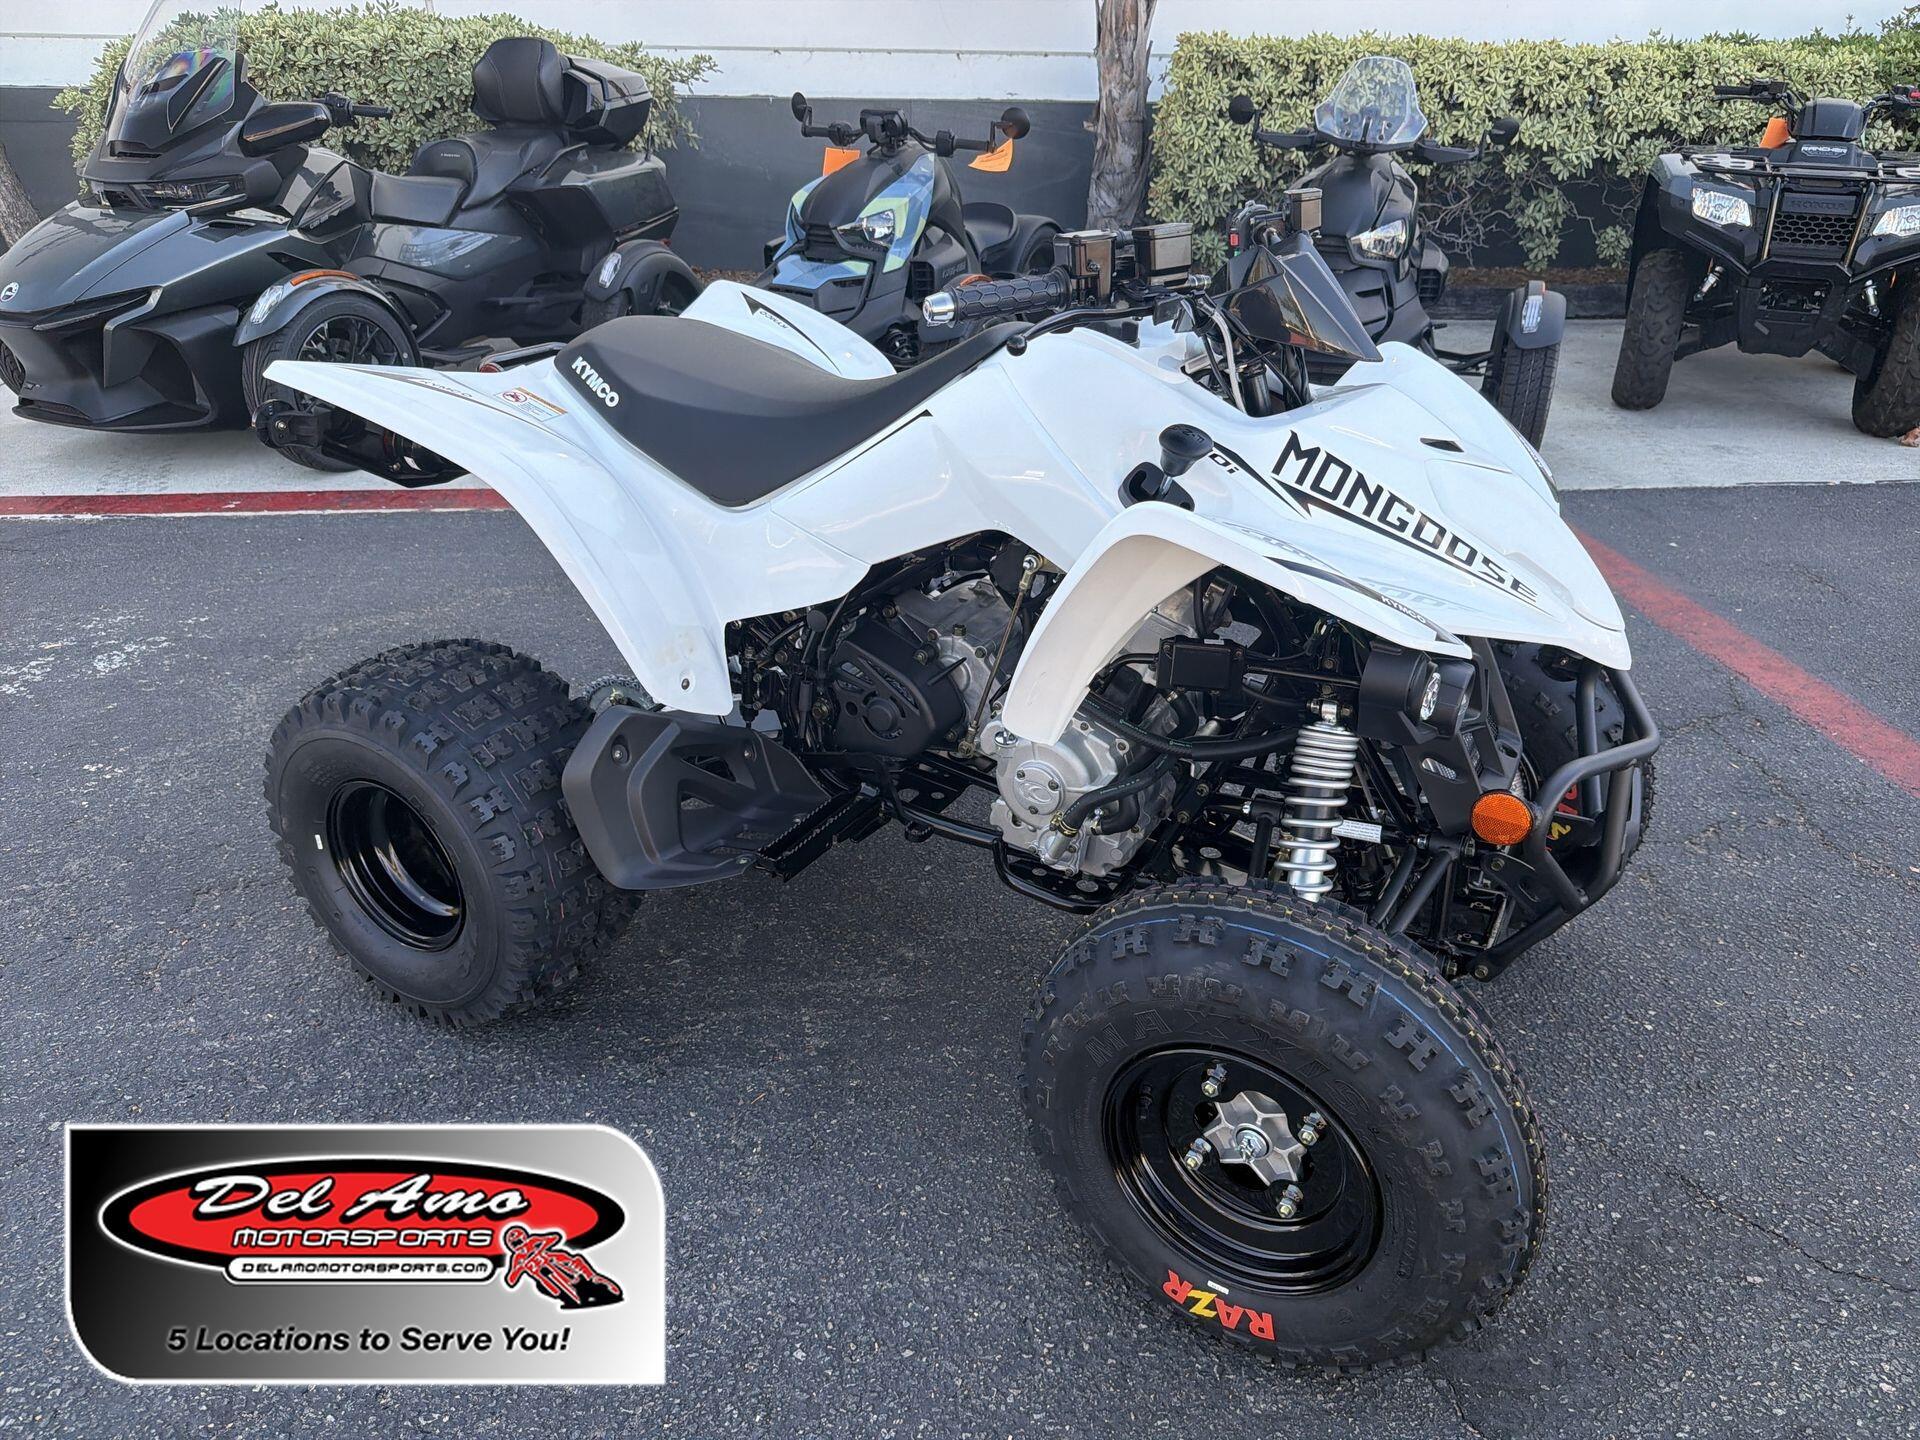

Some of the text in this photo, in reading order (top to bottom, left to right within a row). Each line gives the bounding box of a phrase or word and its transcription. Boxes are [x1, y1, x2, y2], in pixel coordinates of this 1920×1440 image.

[1801, 146, 1848, 154] RANCHER
[571, 356, 619, 408] KYMCO
[1271, 429, 1538, 603] MONGOOSE
[1380, 595, 1428, 624] KYMCO
[1162, 1268, 1276, 1341] RAZR
